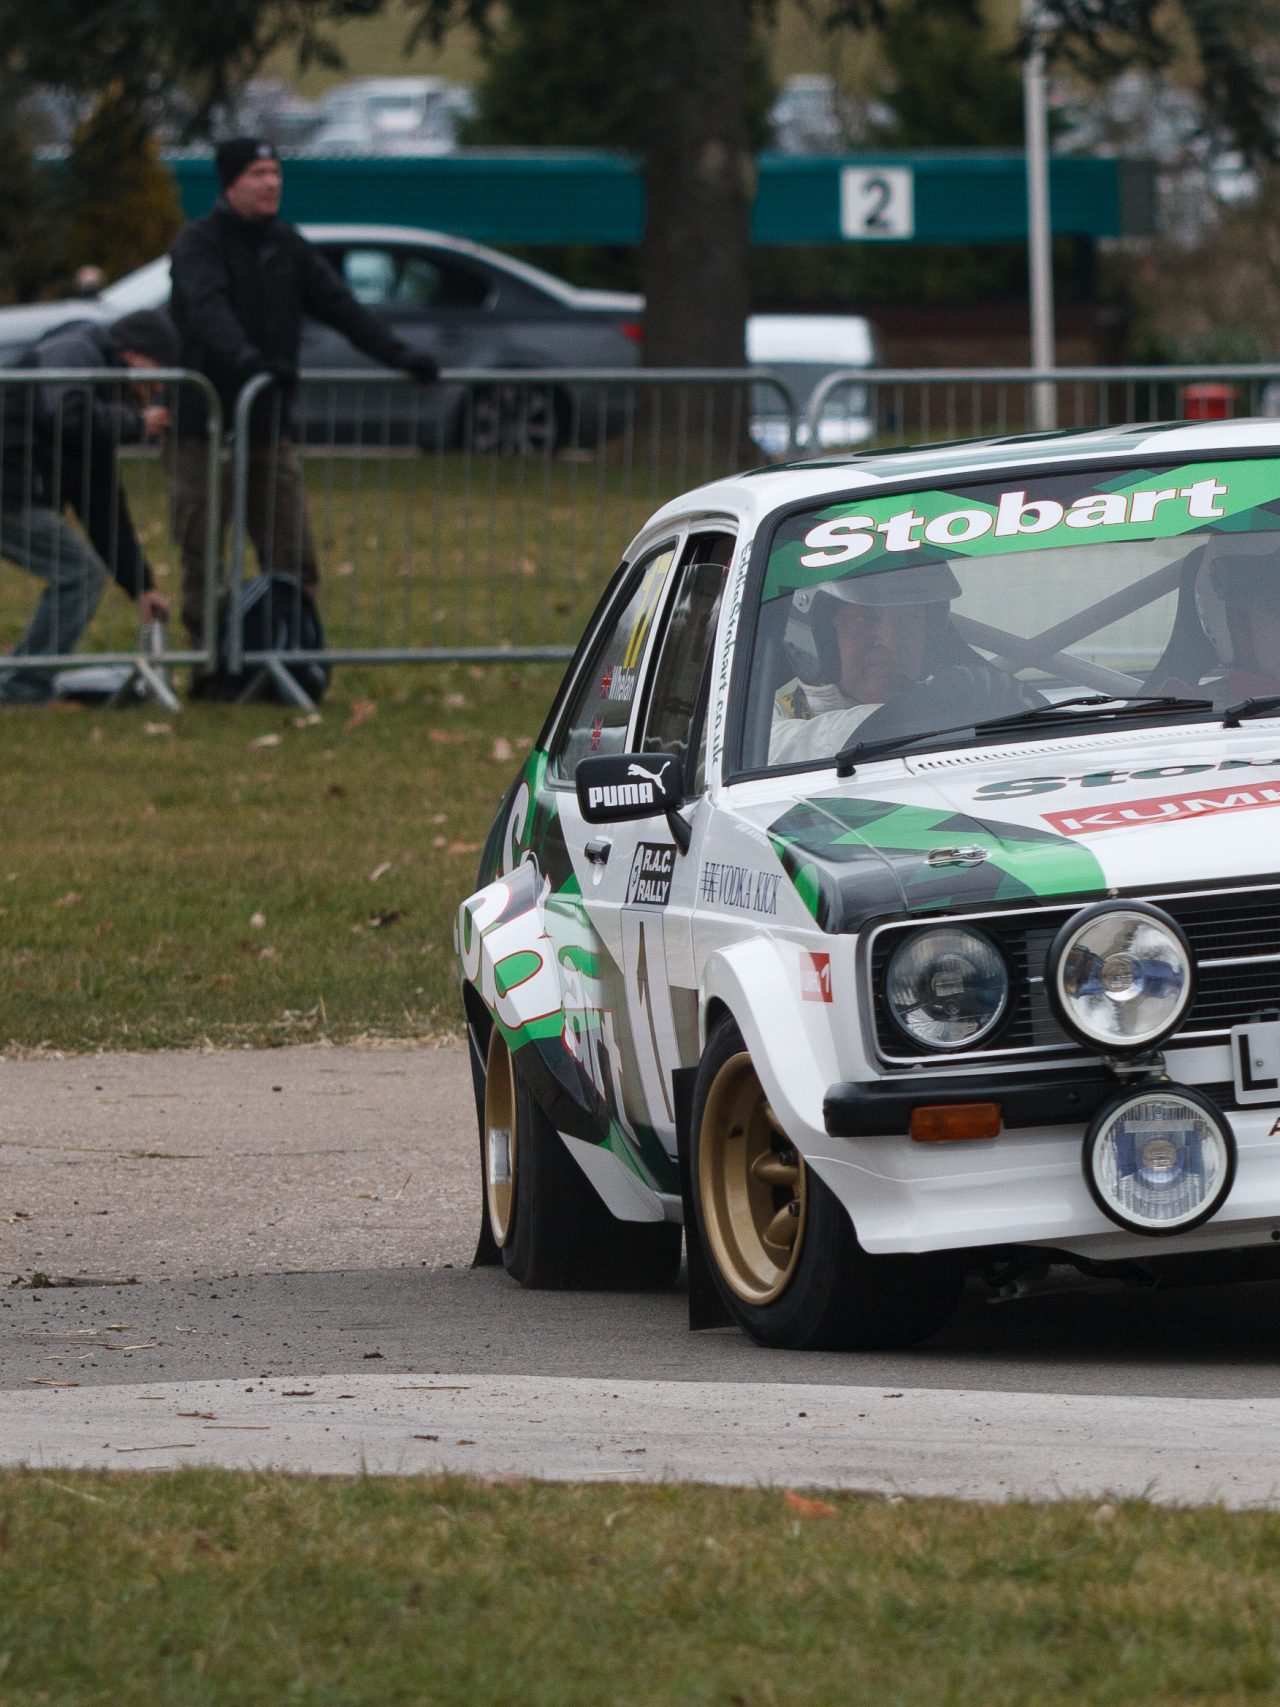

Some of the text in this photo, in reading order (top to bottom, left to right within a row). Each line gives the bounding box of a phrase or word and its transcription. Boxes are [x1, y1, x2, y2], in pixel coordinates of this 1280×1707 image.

[863, 178, 891, 229] 2
[800, 478, 1229, 568] Stobart
[588, 782, 654, 809] PUMA
[642, 849, 672, 873] R.A.C.
[636, 879, 670, 903] RALLY
[753, 871, 782, 915] KICK
